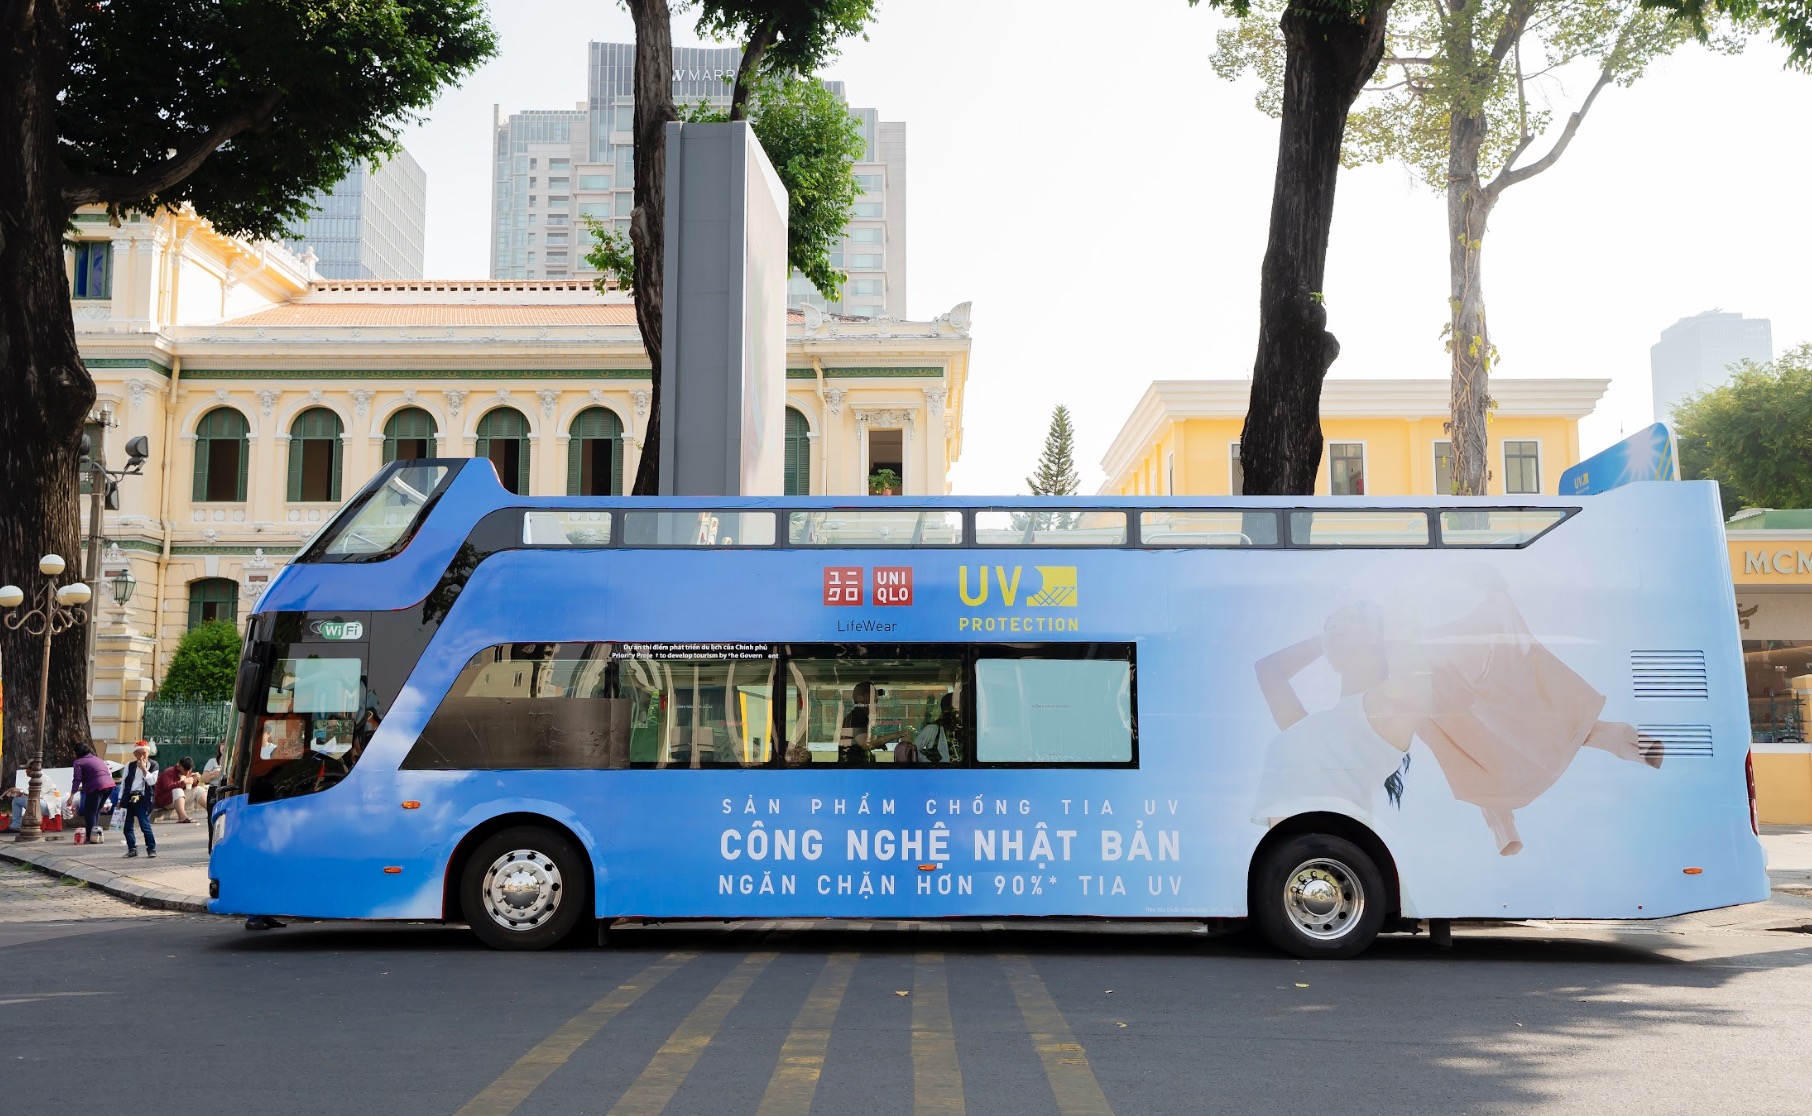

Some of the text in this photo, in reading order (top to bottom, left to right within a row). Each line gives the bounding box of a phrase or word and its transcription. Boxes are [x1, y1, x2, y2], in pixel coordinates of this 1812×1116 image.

[1744, 550, 1812, 574] MCM
[877, 571, 906, 585] UNI
[959, 566, 1022, 607] UV
[877, 587, 909, 604] QLO
[837, 619, 898, 632] LifeWear
[959, 617, 1079, 632] PROTECTION
[722, 792, 1179, 815] SẢN PHẨM CHỐNG TIA UV
[720, 820, 1180, 869] CÔNG NGHỆ NHẬT BẢN
[719, 871, 796, 895] NGĂN
[817, 871, 895, 899] CHẶN
[917, 873, 972, 895] HƠN
[1079, 875, 1127, 895] TIA
[1148, 875, 1182, 895] UV
